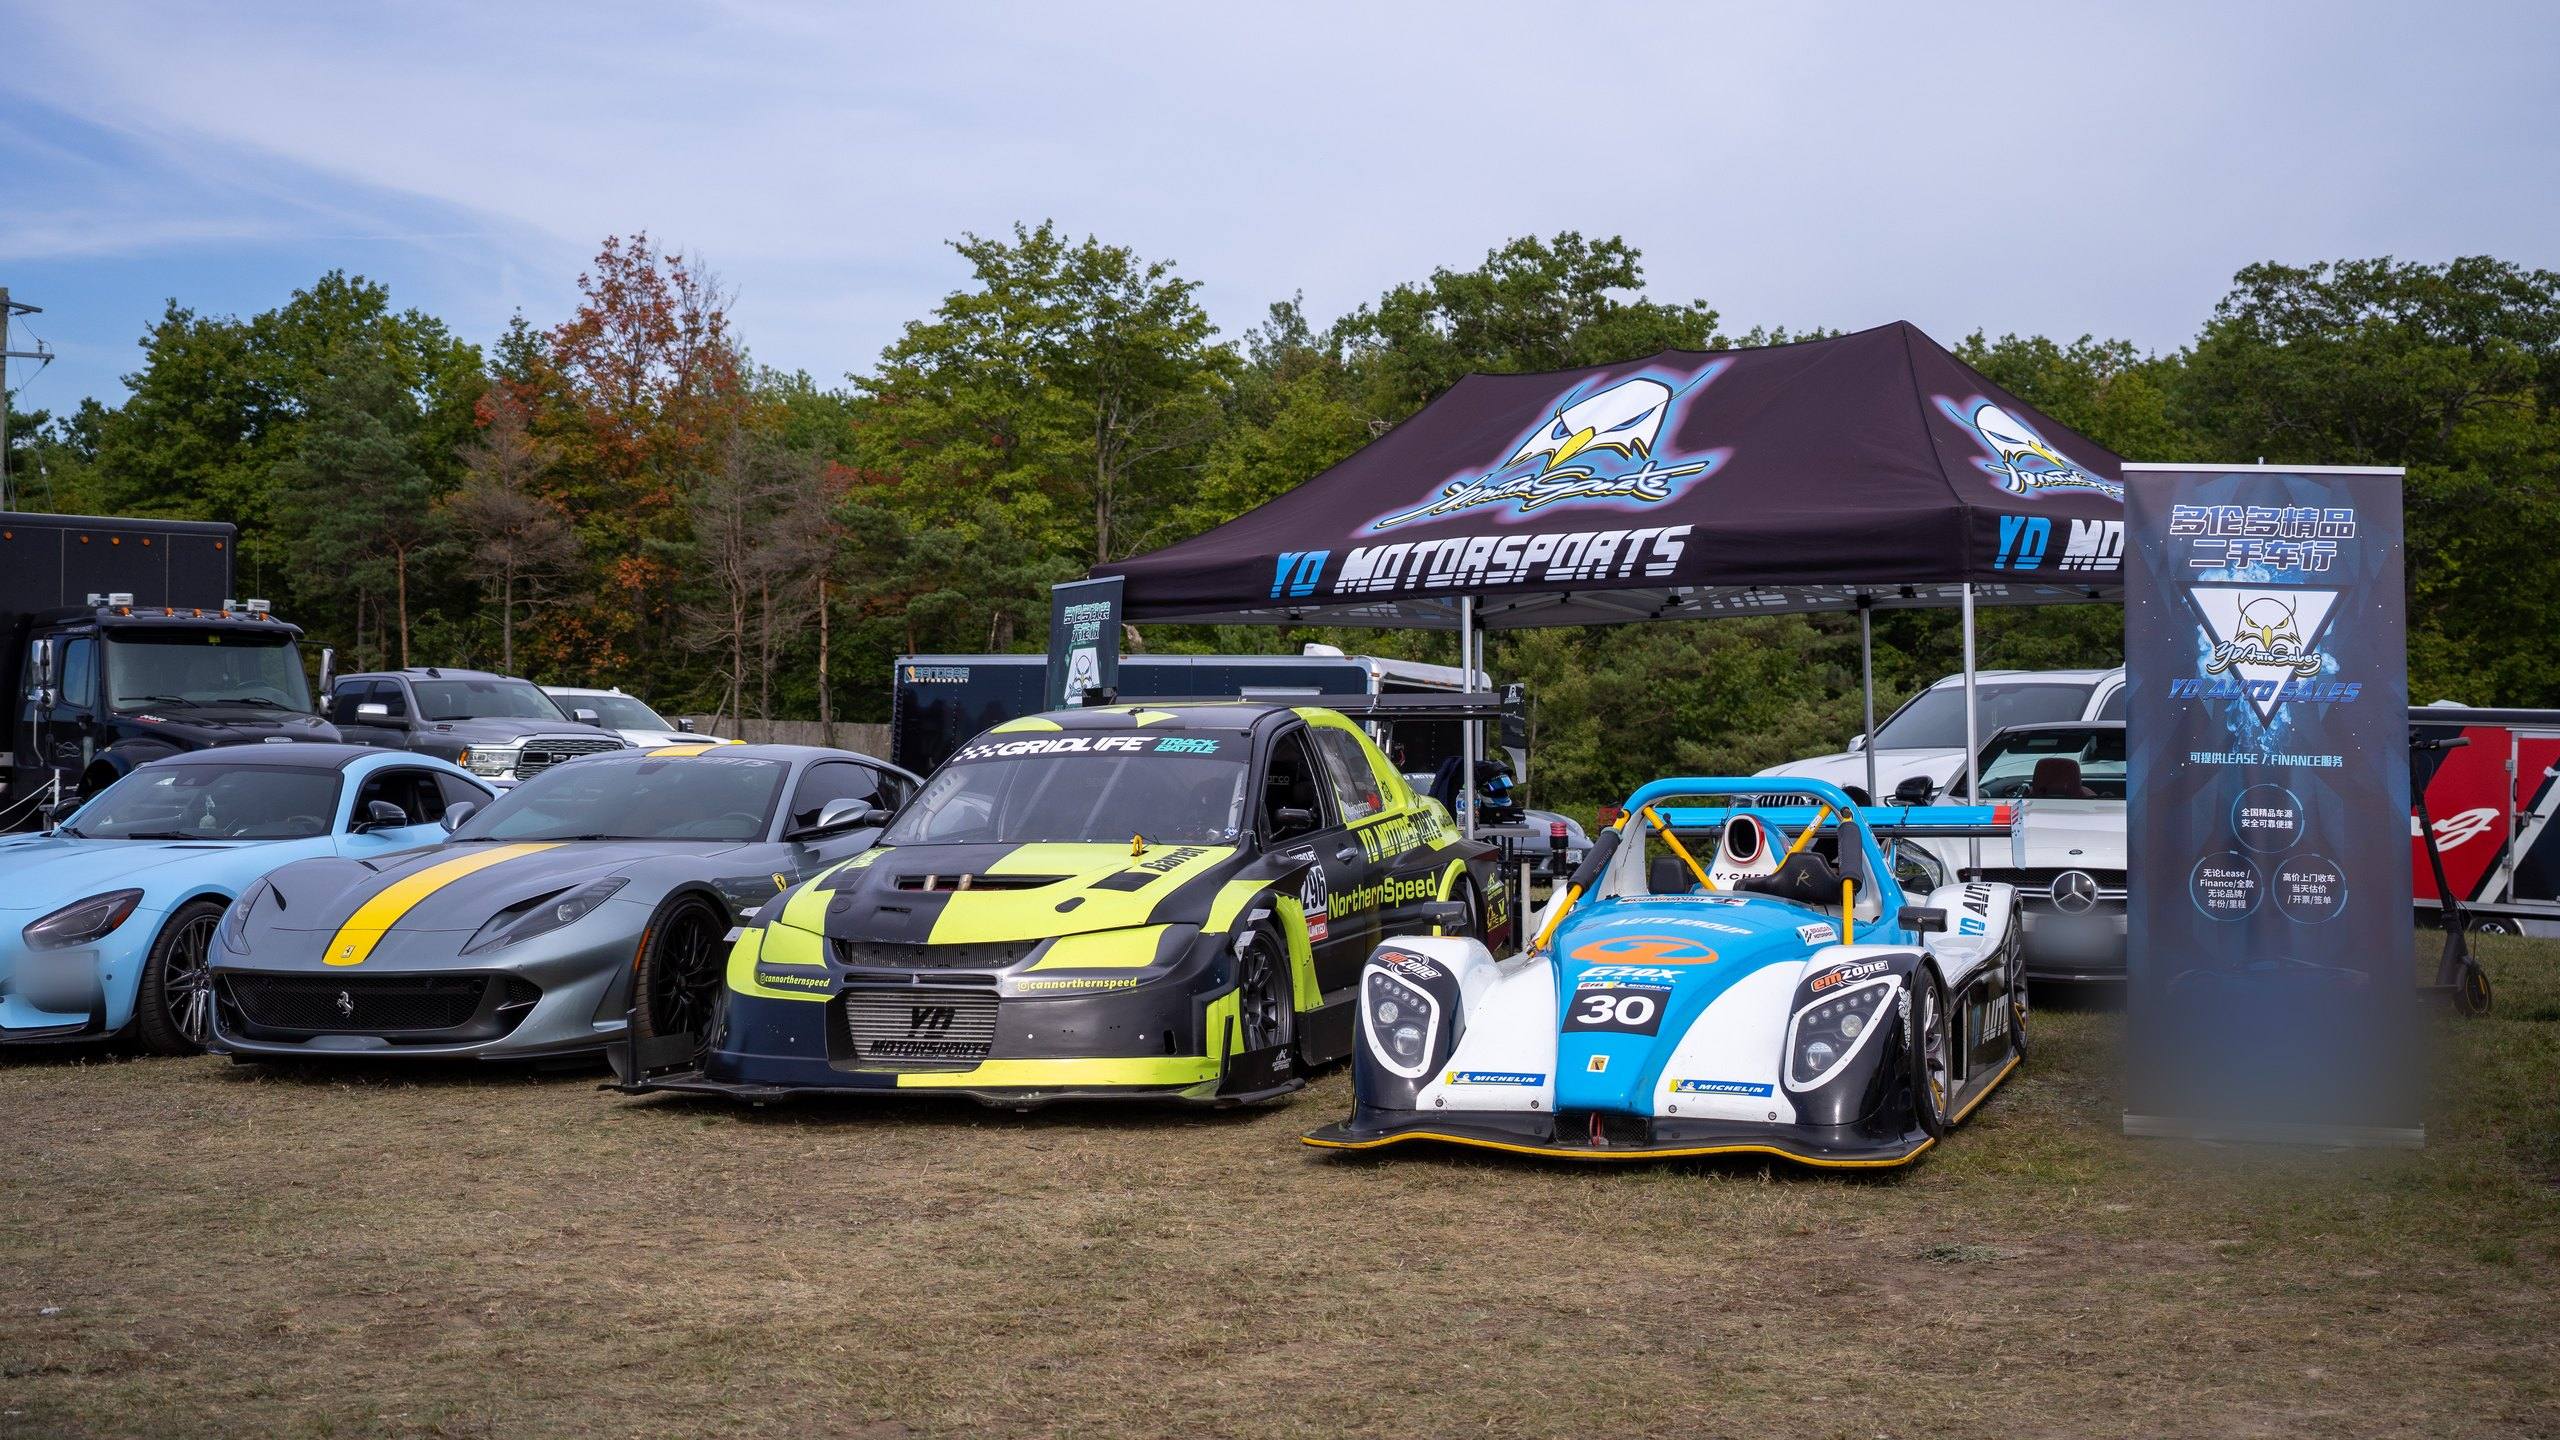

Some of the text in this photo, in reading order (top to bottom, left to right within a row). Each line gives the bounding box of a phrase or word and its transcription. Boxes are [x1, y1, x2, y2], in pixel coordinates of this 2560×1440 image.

[2169, 505, 2356, 538] 多伦多精品
[1994, 515, 2125, 571] YO MO
[1270, 524, 1696, 598] YO MOTORSPORTS
[2190, 539, 2338, 571] 二手车行
[2168, 678, 2363, 704] YO AUTO SALES
[997, 737, 1157, 756] GRIDLIFE
[1154, 744, 1220, 754] BATTLE
[1159, 737, 1220, 747] TRACK
[2241, 808, 2293, 819] 全国精品车源
[2241, 818, 2293, 830] 安全可靠便捷
[1358, 826, 1379, 863] YO
[1140, 847, 1209, 872] Garrett
[2282, 872, 2336, 883] 高价上门收车
[1328, 872, 1437, 920] NorthernSpeed
[2291, 884, 2327, 894] 当天估价
[1607, 917, 1673, 927] AUTO
[1674, 918, 1754, 935] GROUP
[1959, 917, 1986, 936] YO
[765, 975, 831, 988] cannorthernspeed
[1030, 977, 1137, 989] cannorthernspeed
[1811, 961, 1887, 991] emzone
[1576, 995, 1655, 1026] 30
[868, 1039, 992, 1058] MOTORSPORTS
[1472, 1075, 1537, 1083] MICHELIN
[1698, 1083, 1765, 1093] MICHELIN
